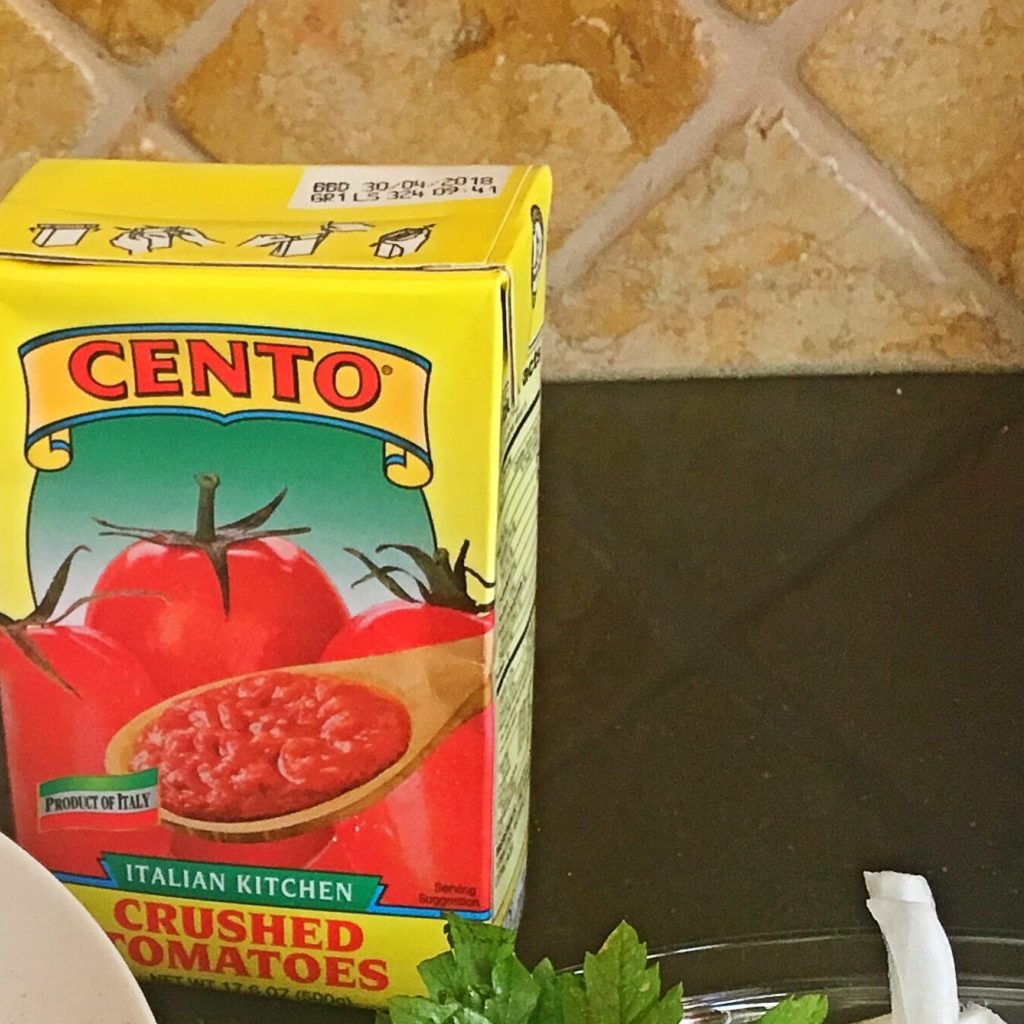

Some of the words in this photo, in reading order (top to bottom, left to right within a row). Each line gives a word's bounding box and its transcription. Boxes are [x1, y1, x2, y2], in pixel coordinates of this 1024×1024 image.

[362, 176, 494, 192] 30/04/2018
[68, 338, 382, 412] CENTO
[126, 863, 225, 892] ITALIAN
[237, 874, 352, 902] KITCHEN
[434, 882, 476, 897] Serving
[418, 893, 480, 908] Suggestion
[113, 898, 364, 953] CRUSHED
